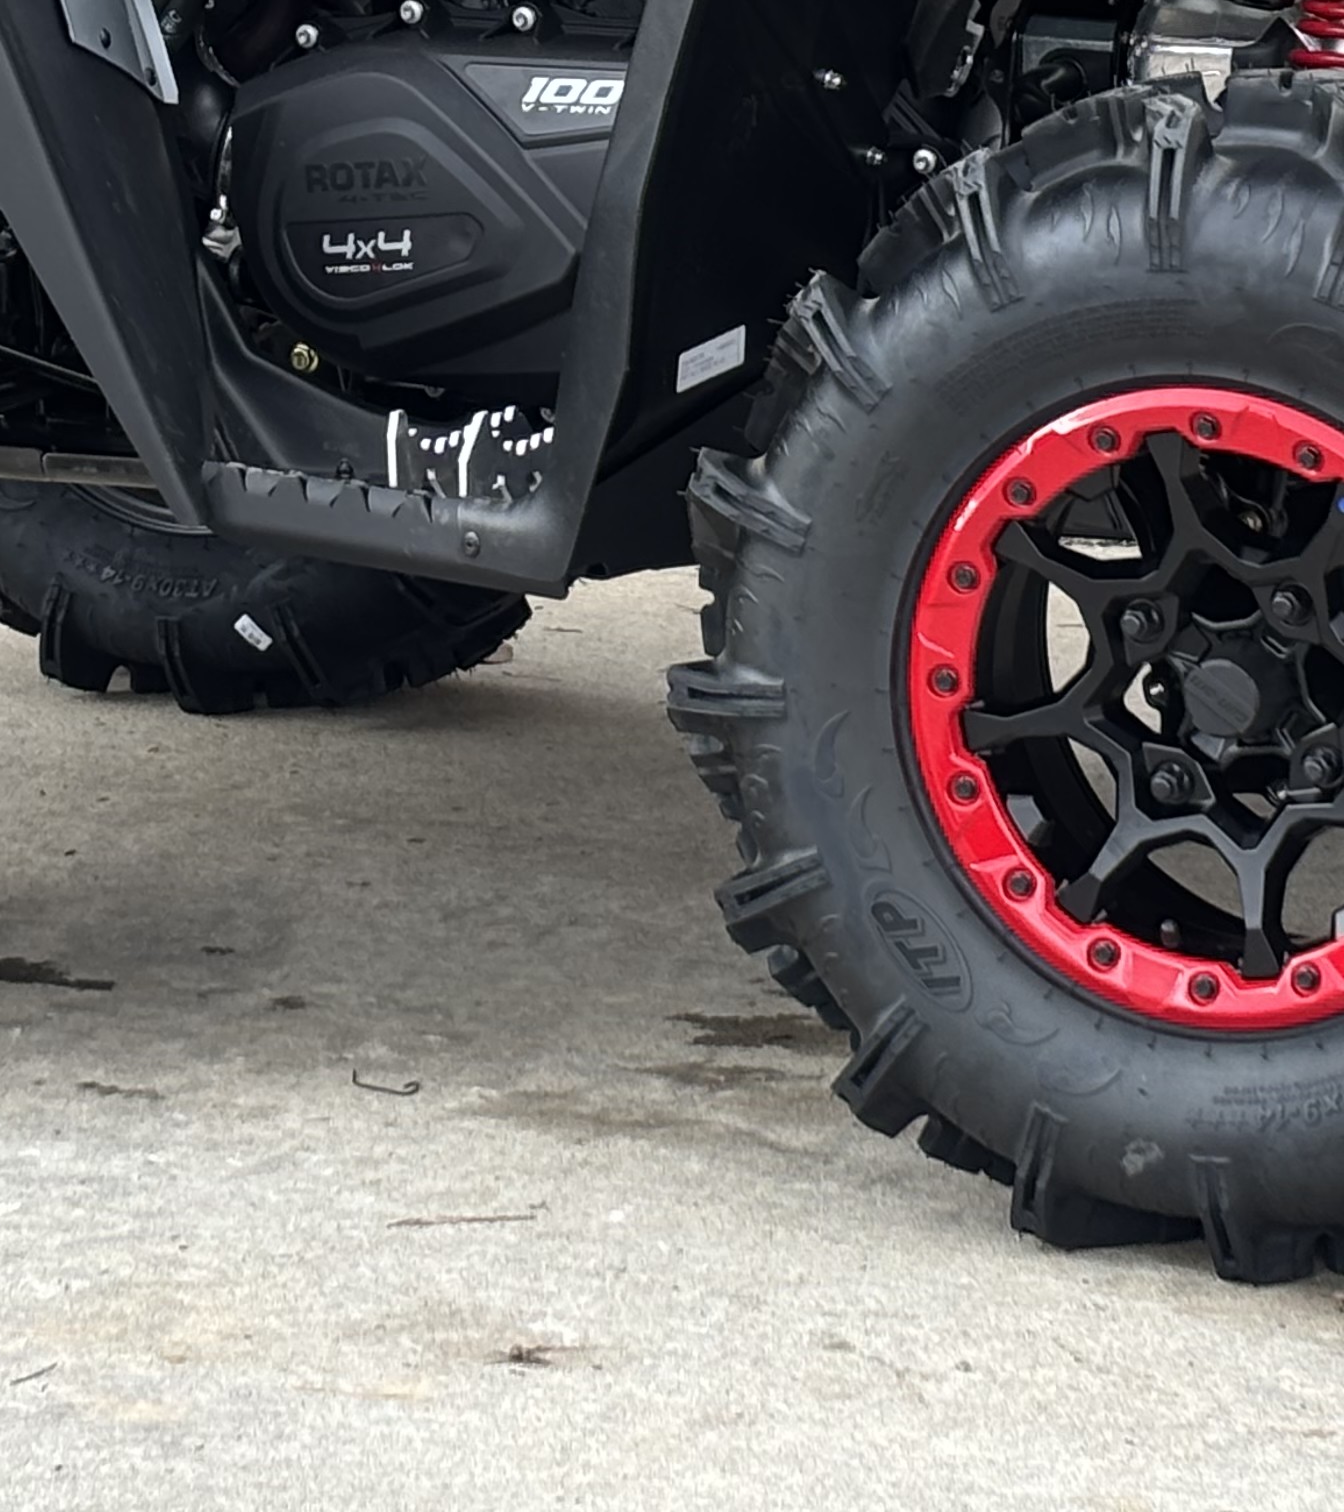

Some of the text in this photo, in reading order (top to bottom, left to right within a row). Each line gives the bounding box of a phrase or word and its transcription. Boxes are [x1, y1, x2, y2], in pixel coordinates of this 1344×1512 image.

[305, 154, 429, 194] ROTAX
[322, 228, 412, 260] 4x4
[871, 899, 962, 997] ITP
